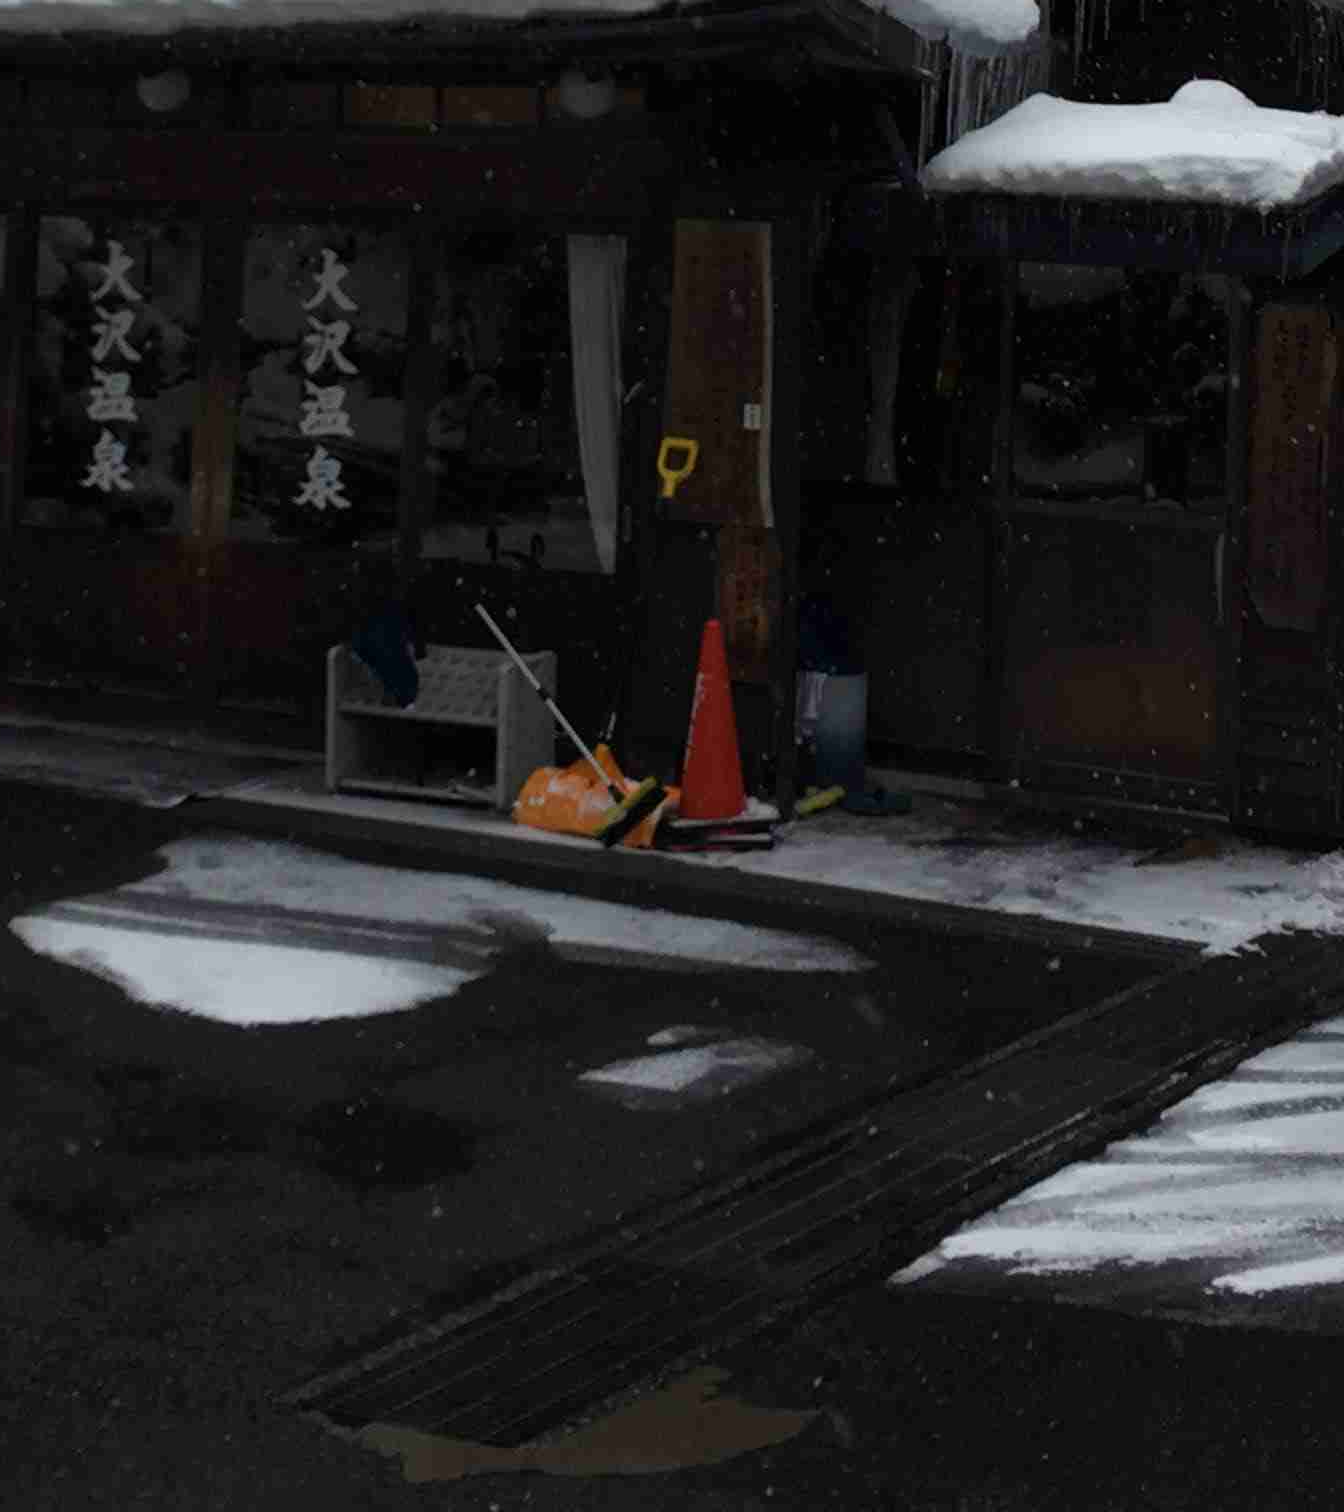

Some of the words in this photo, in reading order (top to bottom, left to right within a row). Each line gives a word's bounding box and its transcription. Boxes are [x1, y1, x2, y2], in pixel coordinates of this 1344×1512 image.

[81, 240, 143, 492] 大沢温泉
[293, 248, 358, 510] 大沢温泉
